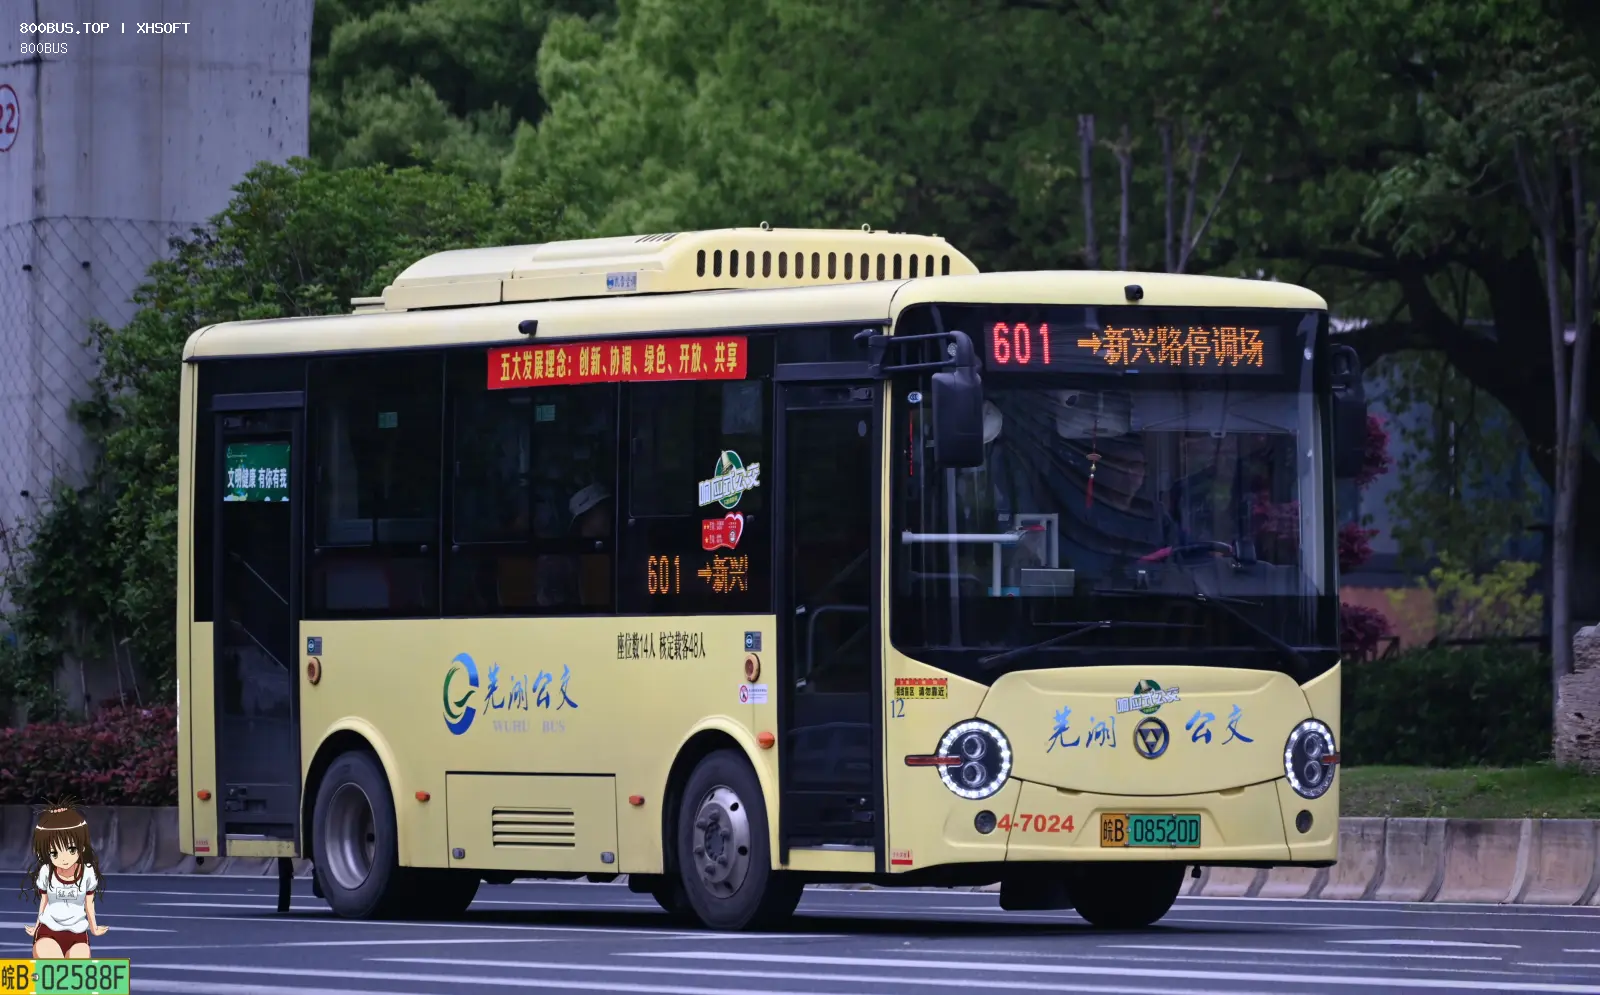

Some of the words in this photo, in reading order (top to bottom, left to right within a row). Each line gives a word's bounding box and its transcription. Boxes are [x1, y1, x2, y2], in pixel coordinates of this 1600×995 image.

[993, 321, 1051, 365] 601
[1103, 324, 1264, 368] 新兴路停调场
[226, 467, 257, 489] 文明健康
[258, 467, 288, 489] 有你有我
[698, 461, 761, 507] 响应式公交
[648, 555, 680, 594] 601
[616, 631, 656, 661] 座位数14人
[659, 630, 706, 661] 核定载客48人
[890, 698, 906, 719] 12
[1115, 686, 1182, 714] 响应式公交
[492, 719, 529, 733] WUHU
[542, 719, 567, 733] BUS
[1046, 705, 1117, 754] 芜湖
[1184, 704, 1255, 746] 公交
[996, 813, 1075, 834] 4-7024
